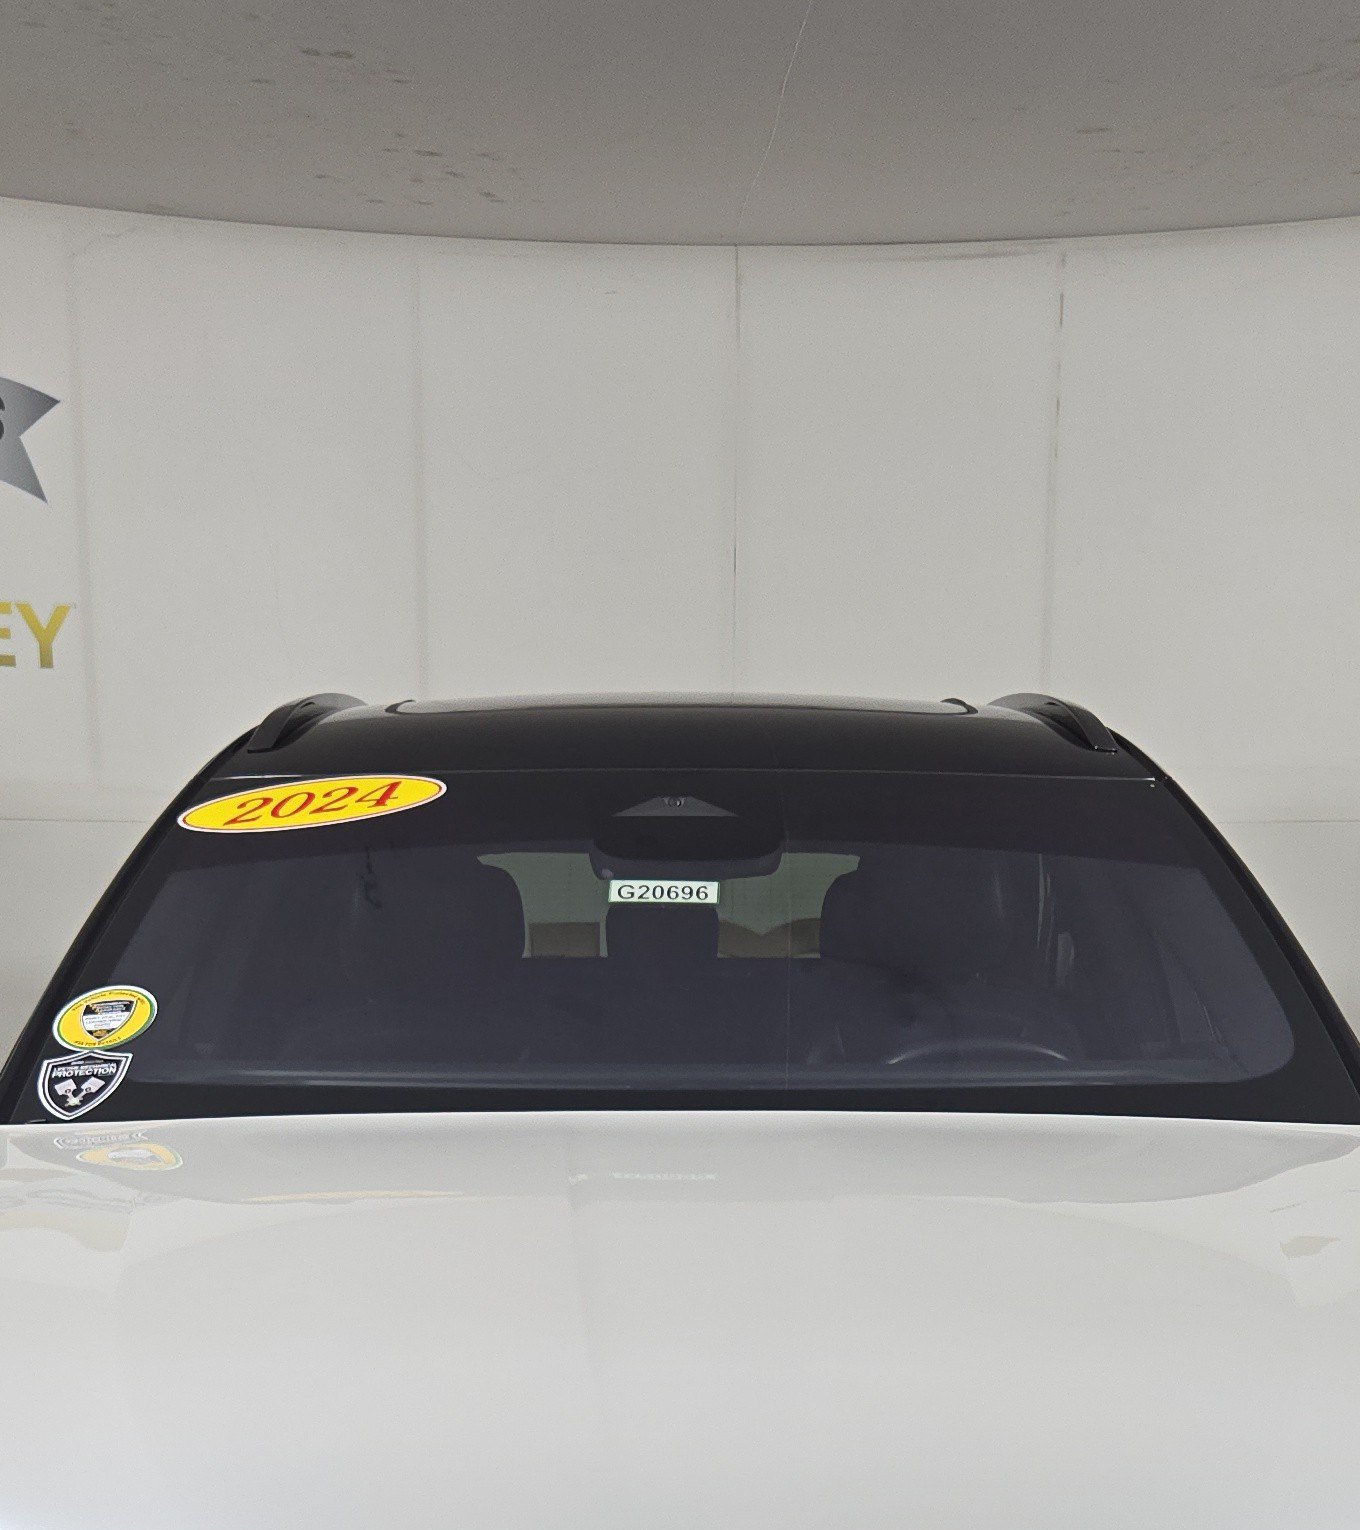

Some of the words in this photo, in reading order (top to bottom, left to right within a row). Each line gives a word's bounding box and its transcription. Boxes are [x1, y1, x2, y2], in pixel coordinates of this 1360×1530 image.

[222, 780, 399, 827] 2024
[616, 884, 710, 901] G20696
[51, 1066, 117, 1079] PROTECTION
